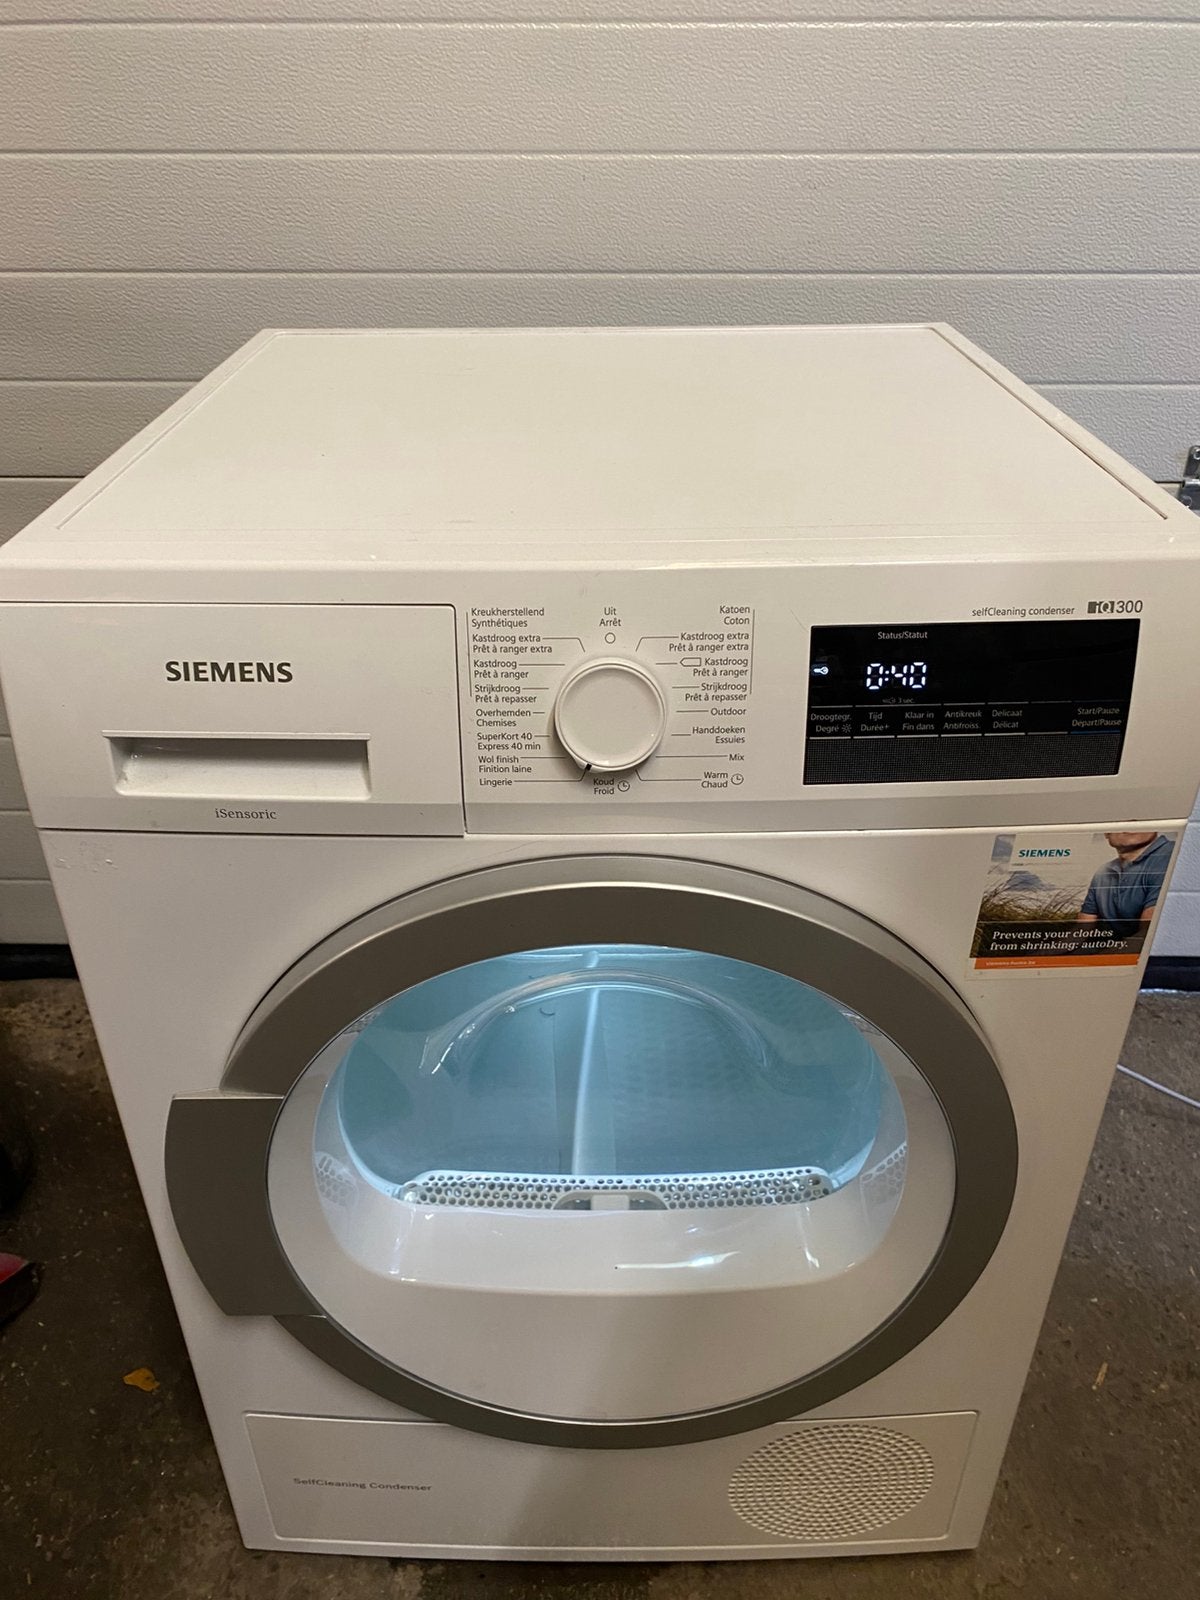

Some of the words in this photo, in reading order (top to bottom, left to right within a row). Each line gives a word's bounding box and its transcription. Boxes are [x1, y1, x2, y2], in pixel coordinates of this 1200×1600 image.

[471, 607, 544, 617] Kreukherstellend
[604, 607, 617, 615] Uit
[719, 606, 750, 614] Katoen
[972, 607, 1026, 618] selfCleaning
[1029, 607, 1075, 615] condenser
[472, 618, 528, 628] Synthétiques
[600, 618, 621, 626] Arrêt
[724, 617, 750, 625] Coton
[473, 634, 516, 644] Kastdroog
[520, 635, 541, 643] extra
[680, 632, 725, 642] Kastdroog
[473, 644, 490, 653] Prêt
[491, 645, 497, 653] à
[499, 646, 527, 655] ranger
[669, 643, 685, 651] Prêt
[688, 643, 693, 651] à
[696, 645, 723, 653] ranger
[474, 660, 517, 669] Kastdroog
[705, 658, 748, 667] Kastdroog
[165, 661, 293, 682] SIEMENS
[474, 670, 490, 678] Prêt
[492, 670, 498, 678] à
[501, 671, 528, 680] ranger
[693, 668, 709, 676] Prêt
[712, 668, 718, 676] à
[721, 669, 748, 678] ranger
[866, 662, 926, 690] 0:40
[475, 685, 520, 694] Strijkdroog
[701, 682, 747, 692] Strijkdroog
[475, 695, 491, 703] Prêt
[494, 695, 499, 703] à
[502, 696, 536, 705] repasser
[685, 693, 701, 701] Prêt
[704, 693, 710, 701] à
[712, 694, 747, 703] repasser
[476, 708, 531, 717] Overhemden
[711, 707, 746, 716] Outdoor
[945, 710, 982, 719] Antikreuk
[1077, 707, 1120, 715] Start/Pauze
[869, 712, 883, 720] Tijd
[476, 719, 516, 727] Chemises
[692, 726, 745, 734] Handdoeken
[477, 732, 519, 742] SuperKort
[521, 732, 532, 740] 40
[716, 735, 745, 744] Essuies
[478, 742, 509, 752] Express
[511, 742, 523, 750] 40
[526, 742, 540, 750] min
[478, 756, 493, 764] Wol
[496, 755, 519, 763] finish
[729, 753, 744, 761] Mix
[479, 765, 509, 773] Finition
[512, 765, 531, 773] laine
[704, 771, 728, 779] Warm
[479, 778, 512, 787] Lingerie
[593, 778, 614, 786] Koud
[701, 780, 728, 788] Chaud
[594, 787, 614, 795] Froid
[215, 809, 277, 819] iSensoric
[1018, 849, 1071, 858] SIEMENS
[993, 931, 1042, 940] Prevents
[1044, 931, 1071, 940] your
[1072, 929, 1113, 937] clothes
[990, 941, 1018, 951] from
[1020, 941, 1079, 951] shrinking:
[1081, 939, 1128, 949] autoDry.
[294, 1478, 366, 1489] SelfCleaning
[369, 1482, 432, 1491] Condenser
